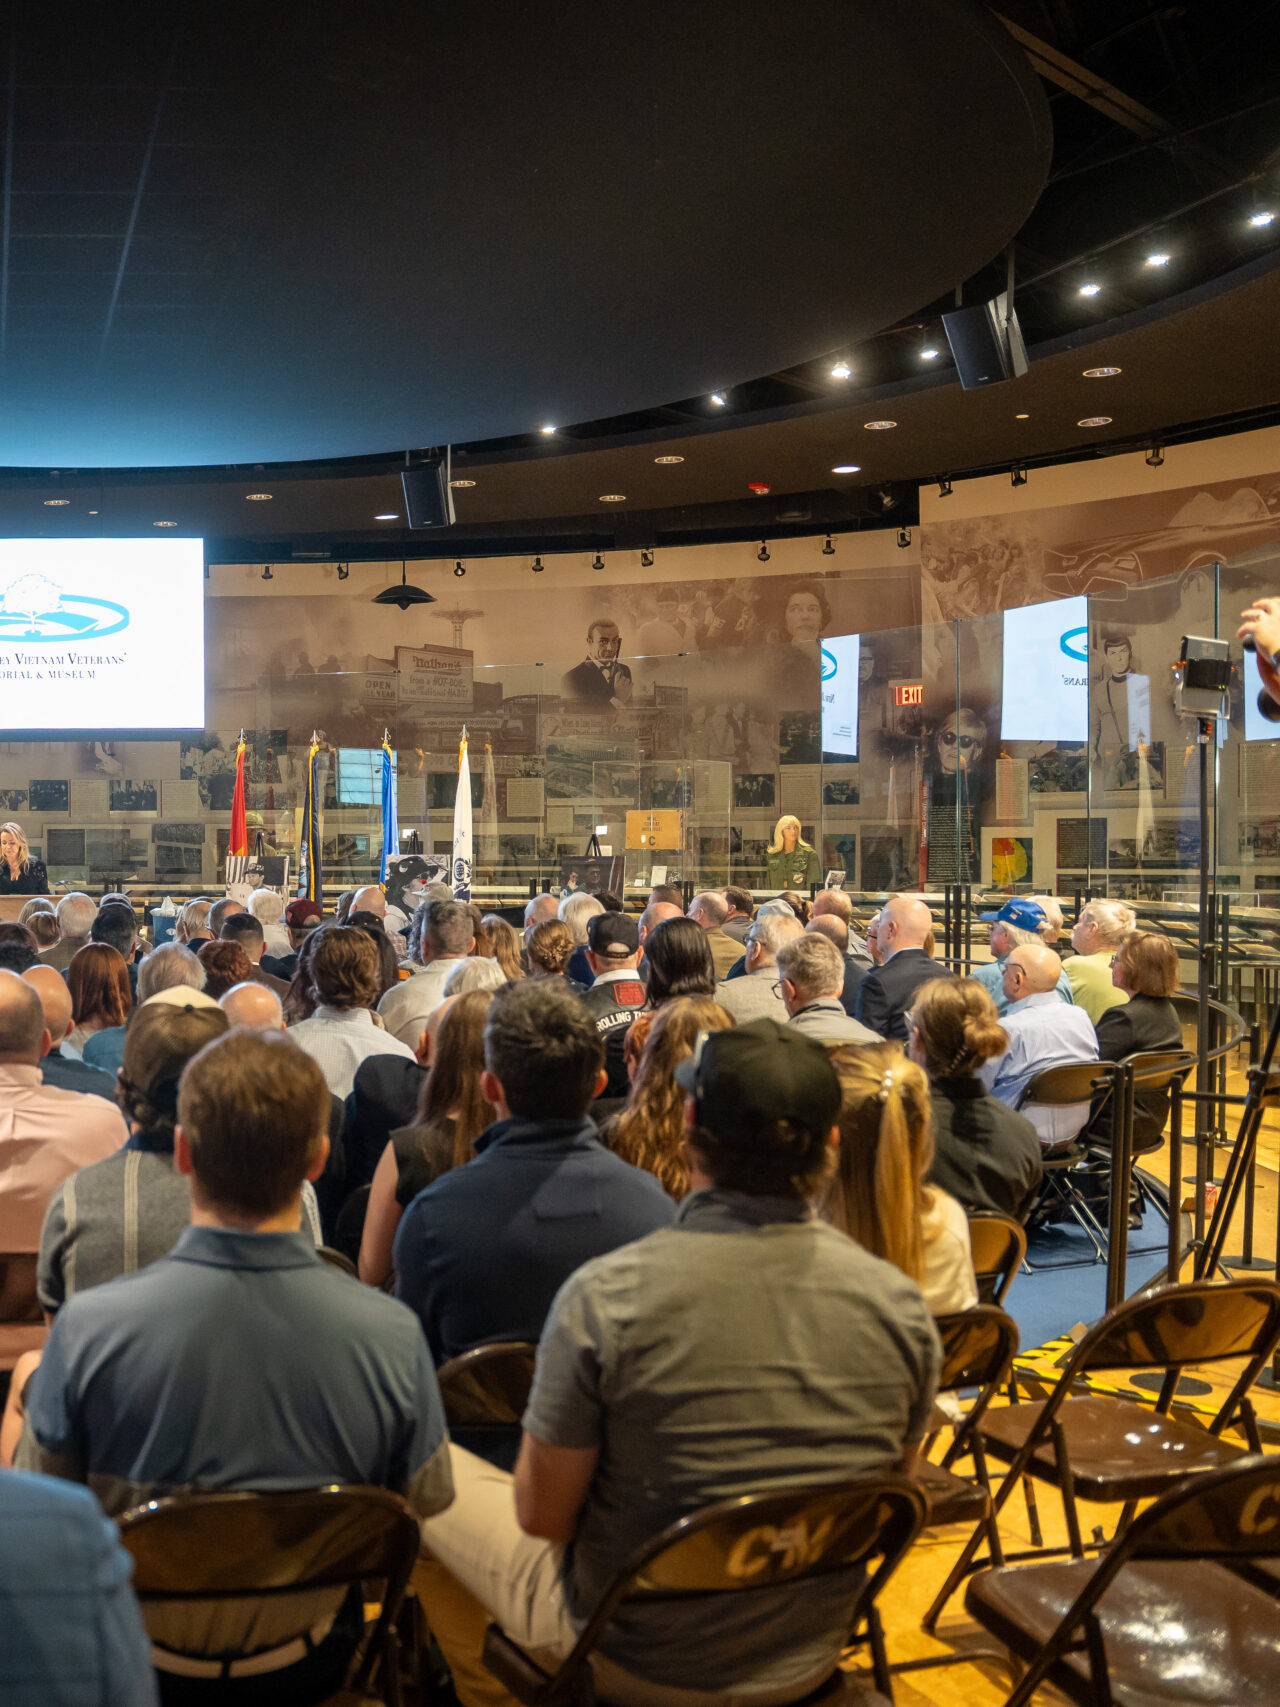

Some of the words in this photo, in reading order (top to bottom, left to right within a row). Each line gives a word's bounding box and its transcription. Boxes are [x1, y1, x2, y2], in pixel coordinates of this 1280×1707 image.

[14, 653, 65, 665] VIETNAM
[36, 671, 44, 679] &
[48, 670, 95, 679] MUSEUM
[365, 680, 391, 690] OPEN
[376, 690, 396, 699] YEAR
[902, 686, 923, 704] EXIT
[648, 835, 656, 846] C
[596, 1011, 631, 1032] ROLLING
